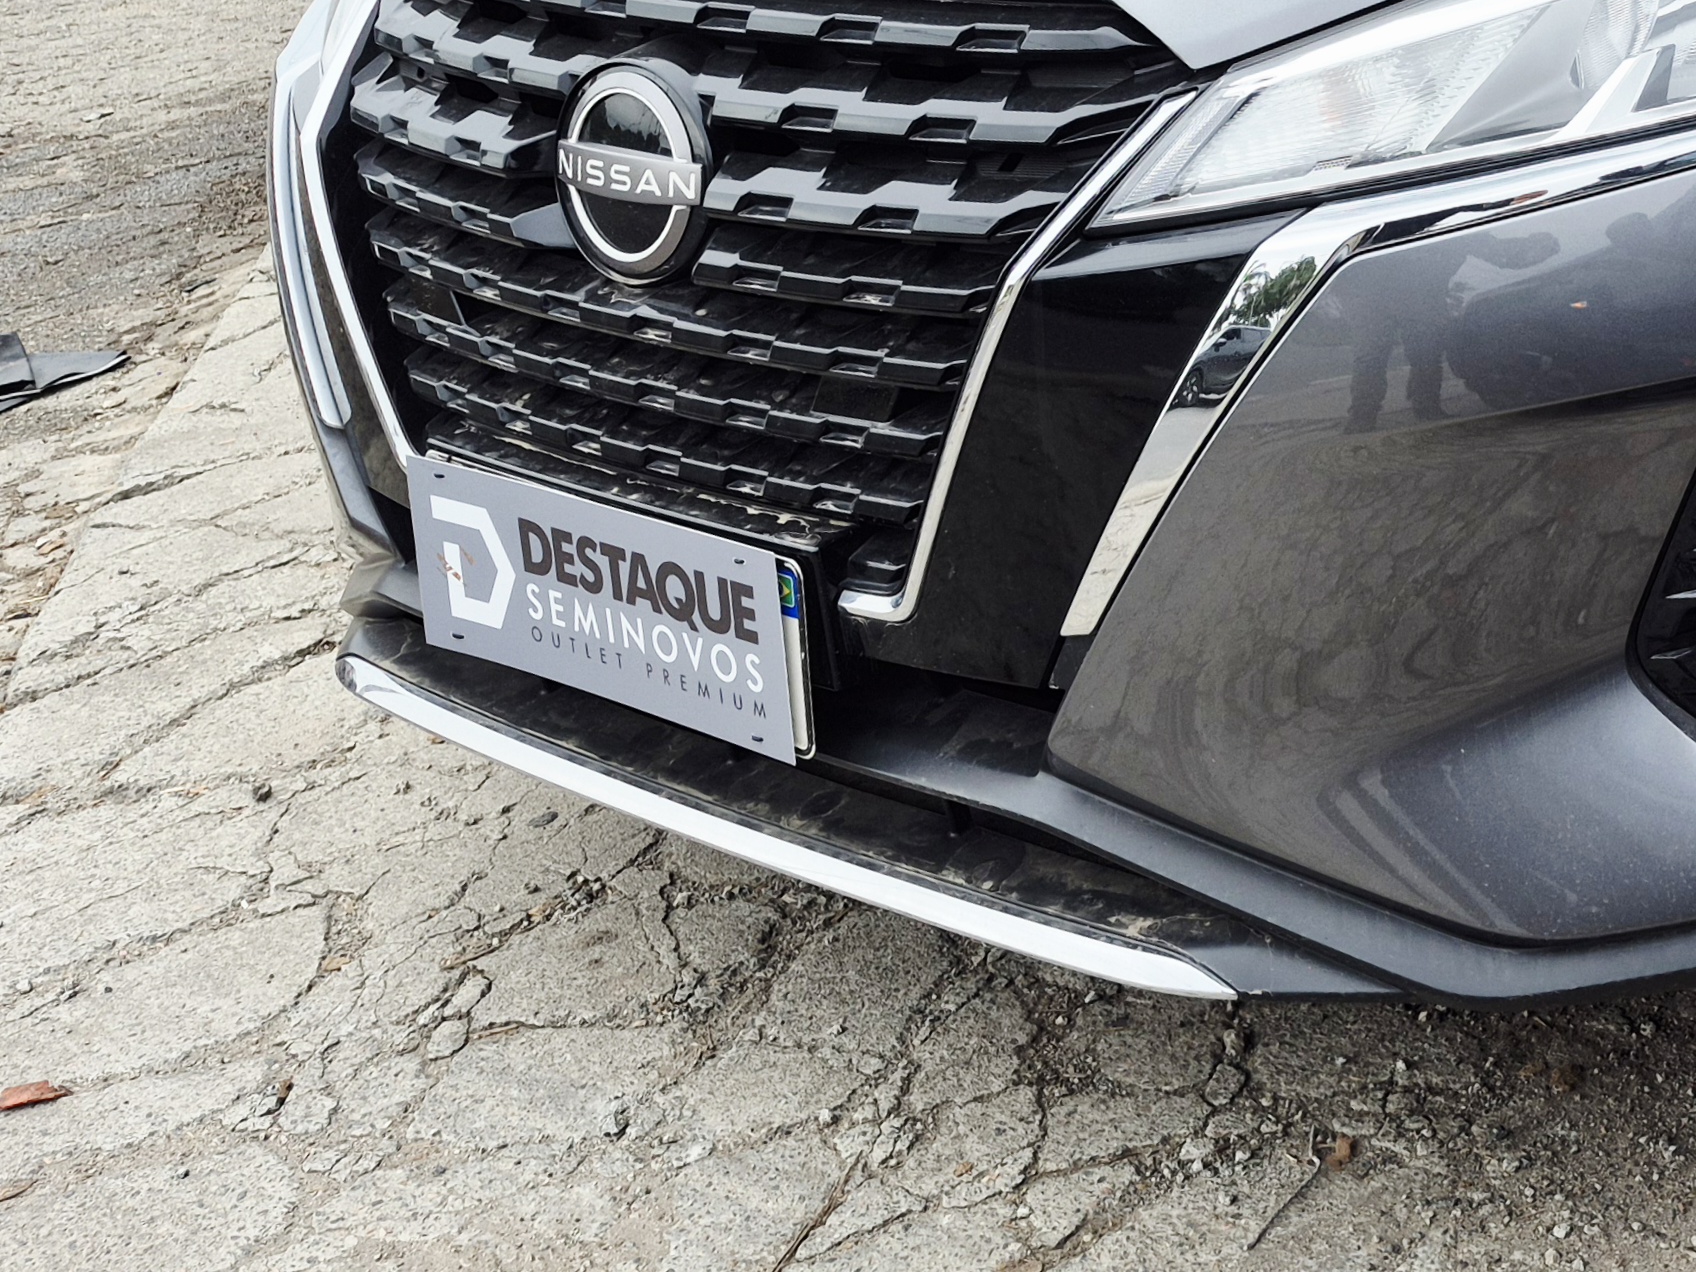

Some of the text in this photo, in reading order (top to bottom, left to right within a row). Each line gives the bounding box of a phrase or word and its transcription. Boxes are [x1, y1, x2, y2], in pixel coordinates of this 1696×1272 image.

[558, 148, 696, 200] NISSAN
[518, 516, 760, 646] DESTAQUE
[526, 583, 765, 693] SEMINOVOS
[531, 627, 768, 721] OUTLET PREMIUM
